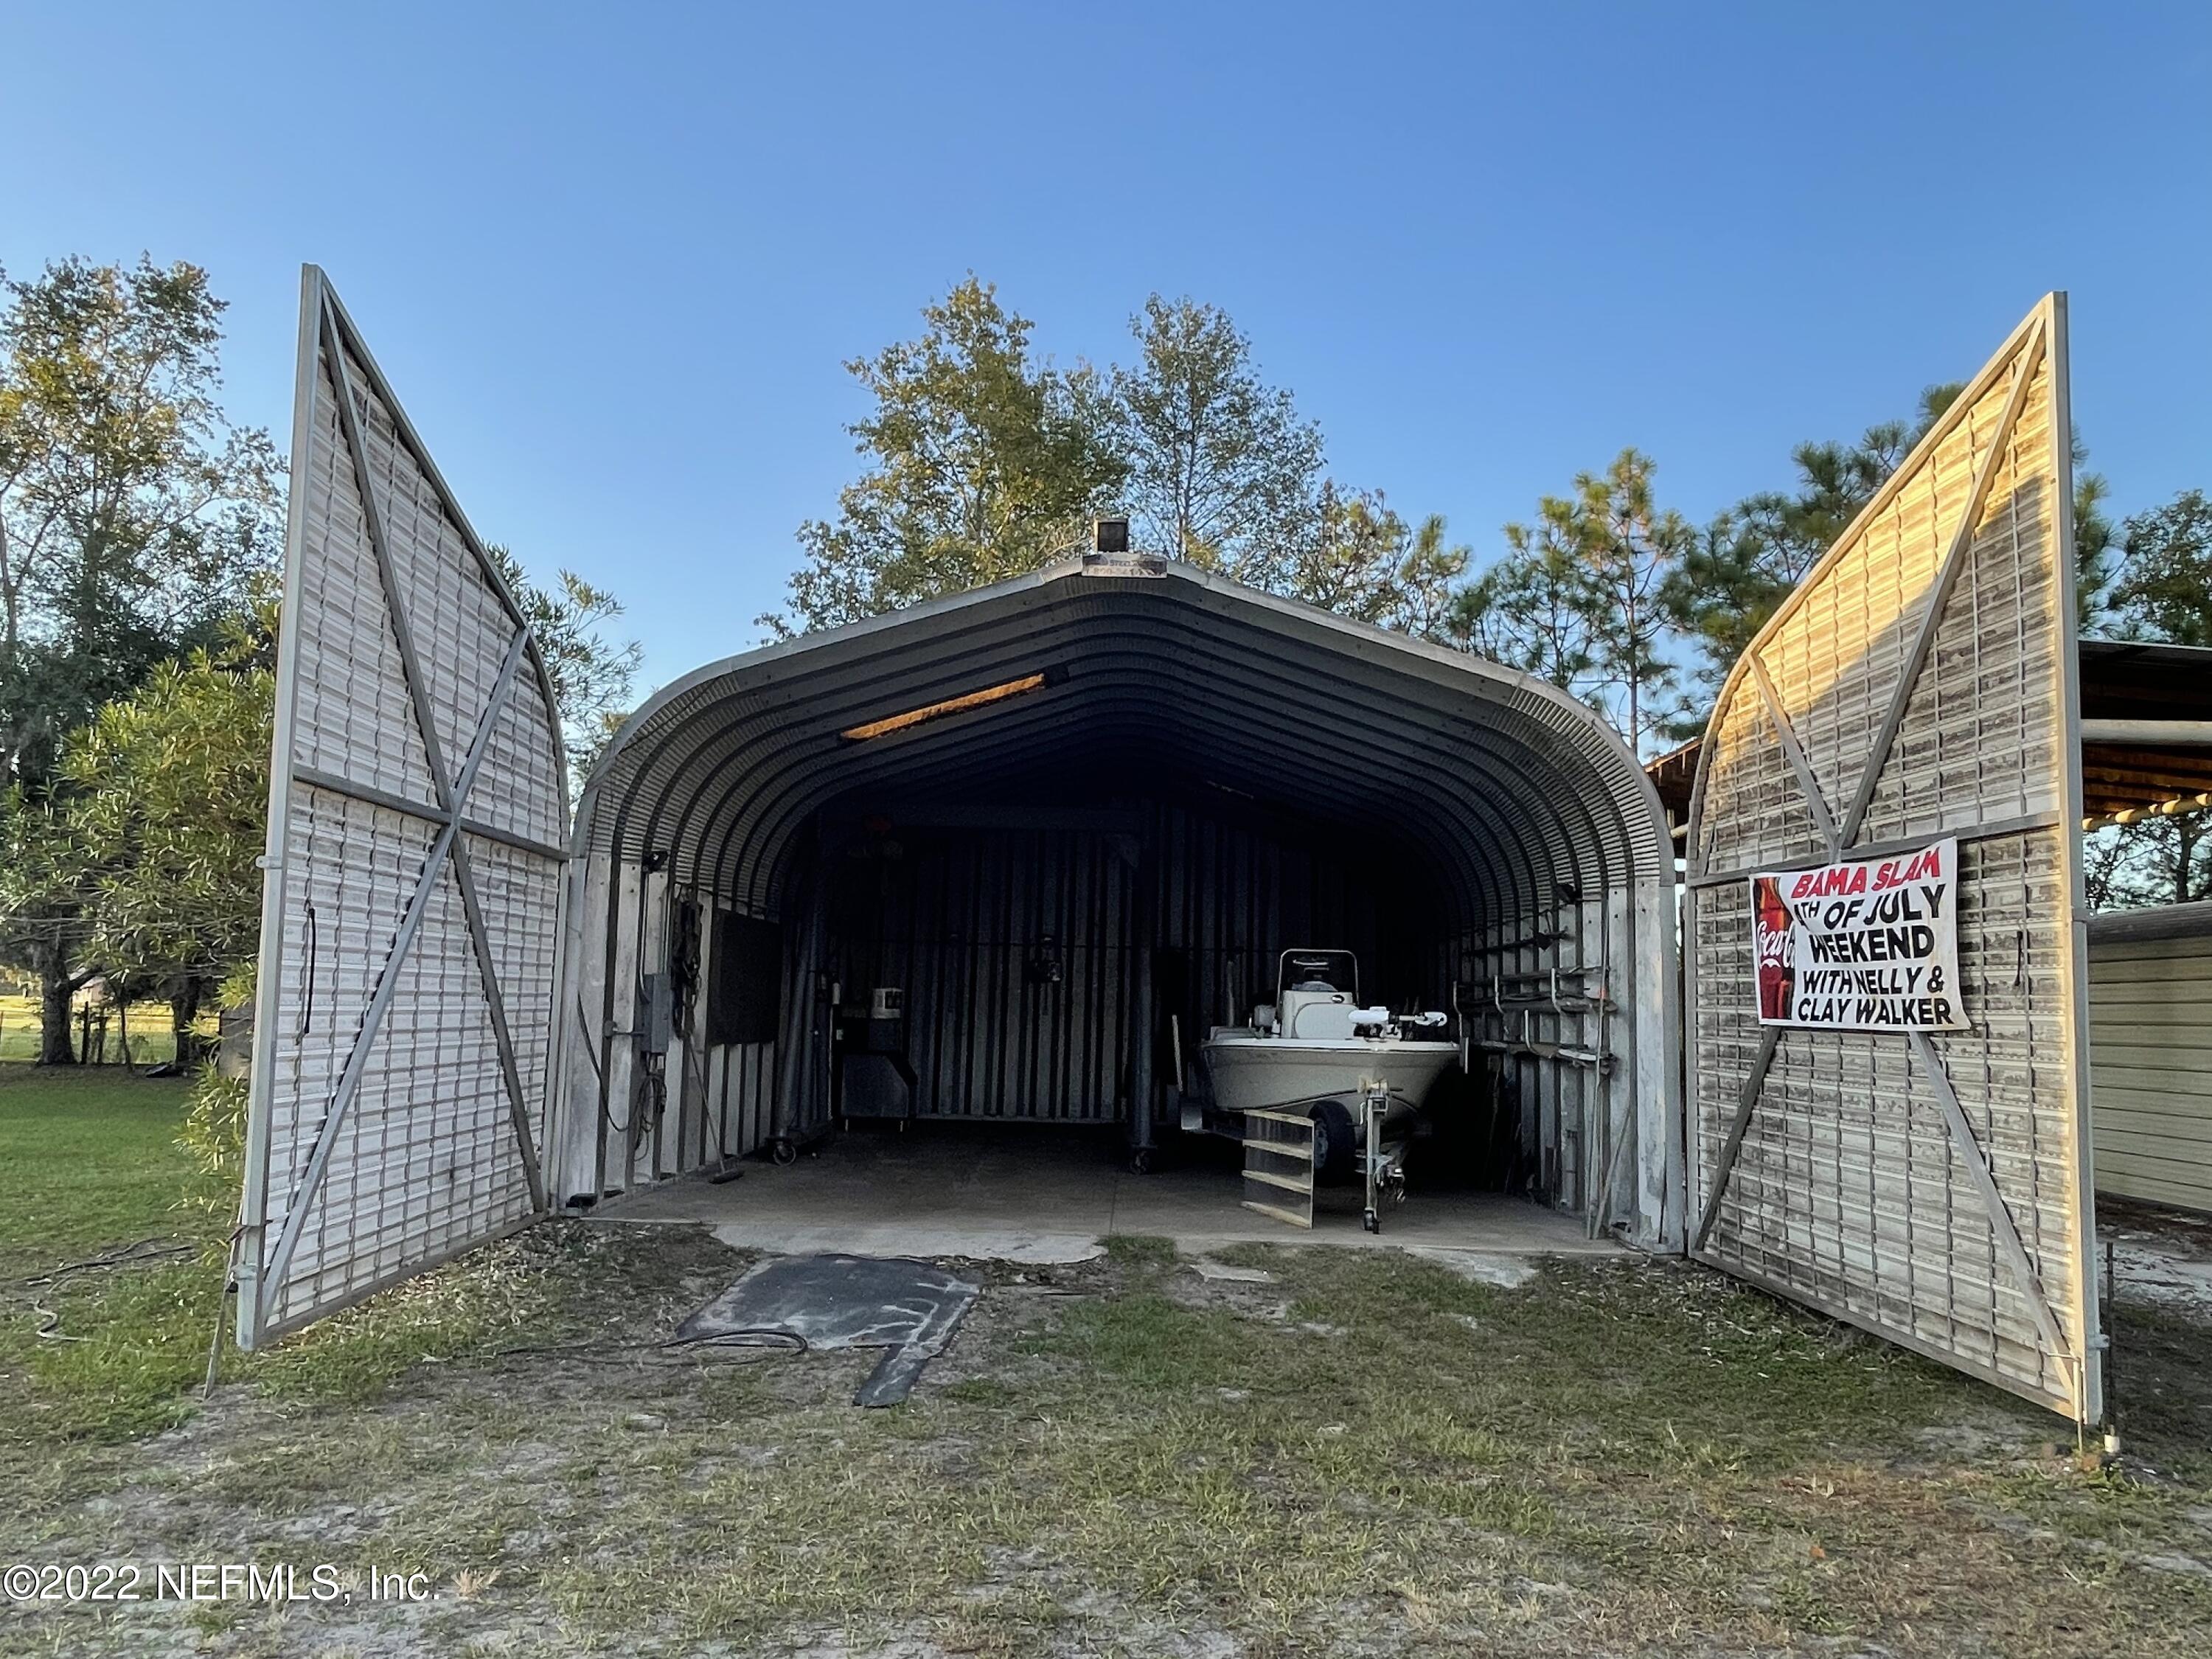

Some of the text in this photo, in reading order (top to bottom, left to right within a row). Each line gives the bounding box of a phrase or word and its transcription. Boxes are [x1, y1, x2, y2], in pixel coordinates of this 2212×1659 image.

[1791, 846, 1941, 899] BAMA SLAM
[1823, 899, 1865, 931] OF
[1863, 883, 1947, 926] JULY
[1809, 925, 1935, 964] WEEKEND
[1804, 965, 1945, 995] WITH NELLY &
[1798, 998, 1955, 1025] CLAY WALKER
